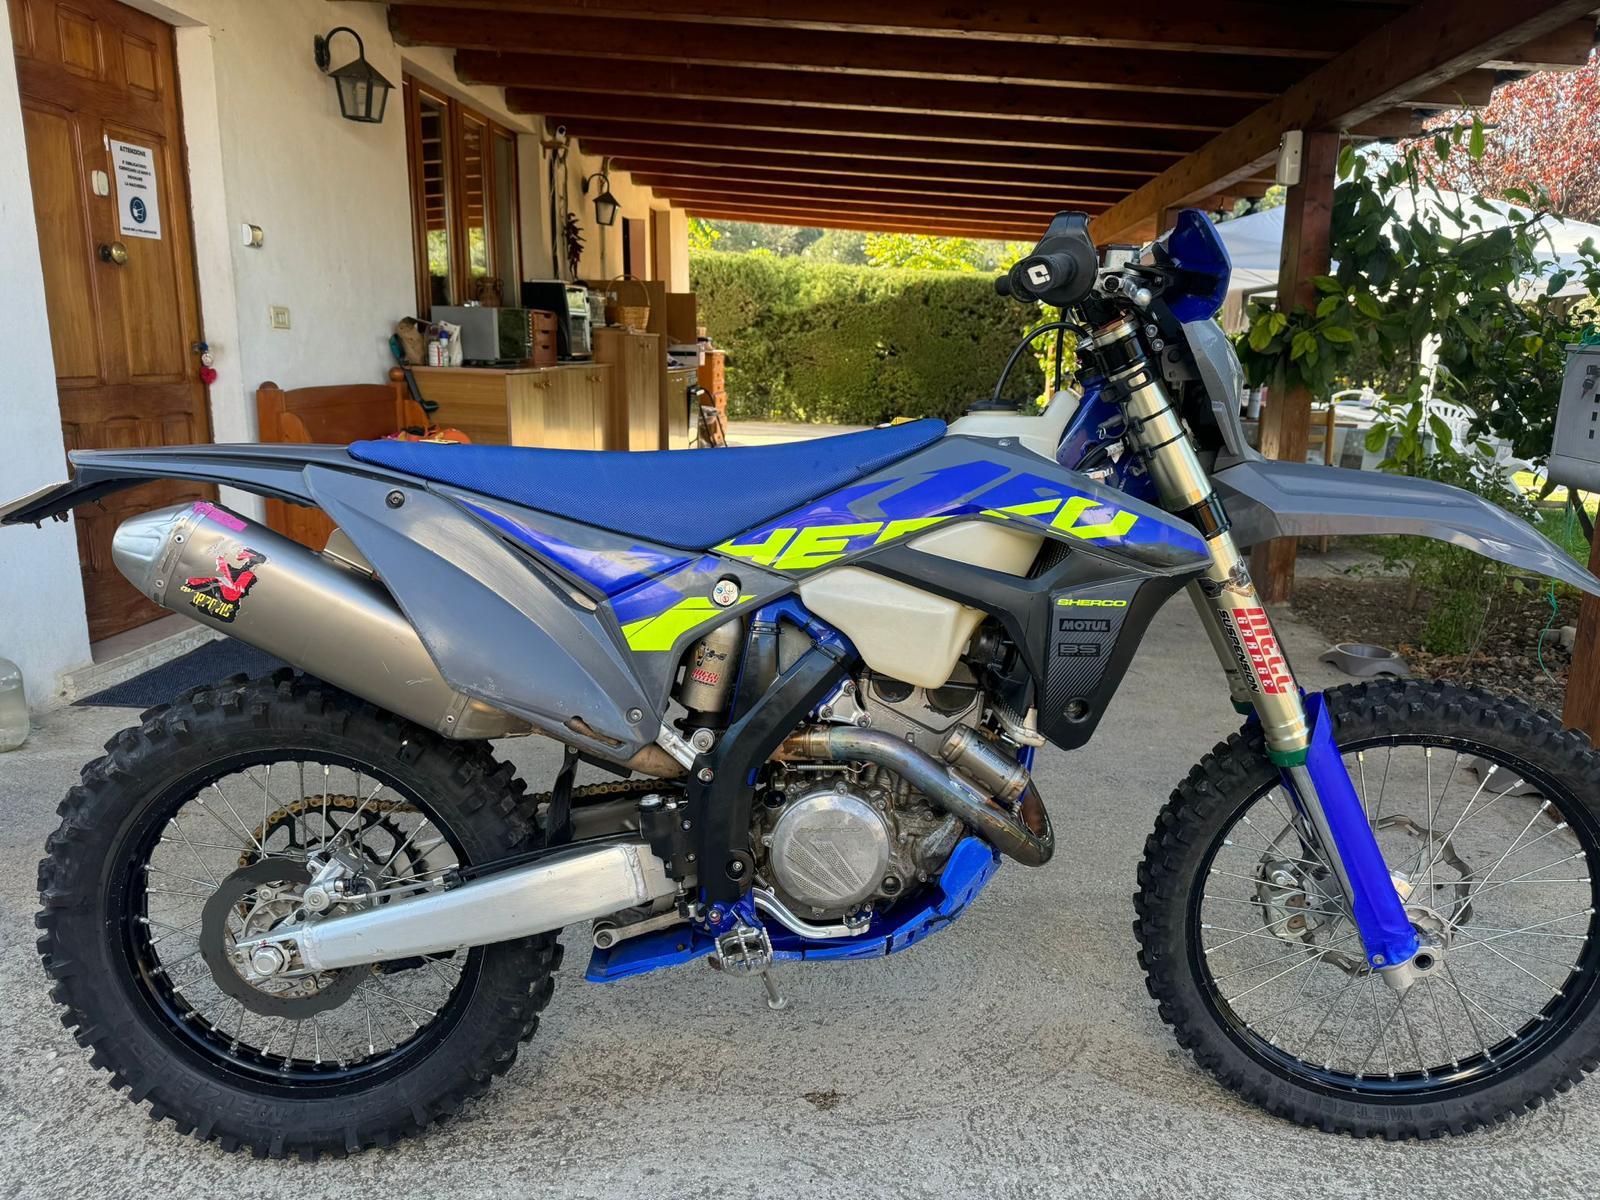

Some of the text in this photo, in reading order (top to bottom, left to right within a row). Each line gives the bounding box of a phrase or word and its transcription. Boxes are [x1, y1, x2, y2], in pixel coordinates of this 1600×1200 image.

[1057, 598, 1127, 607] SHERCO
[1061, 620, 1108, 631] MOTUL
[1060, 644, 1097, 653] BS
[1218, 608, 1260, 693] SUSPENSION
[1237, 616, 1274, 688] GARAGE
